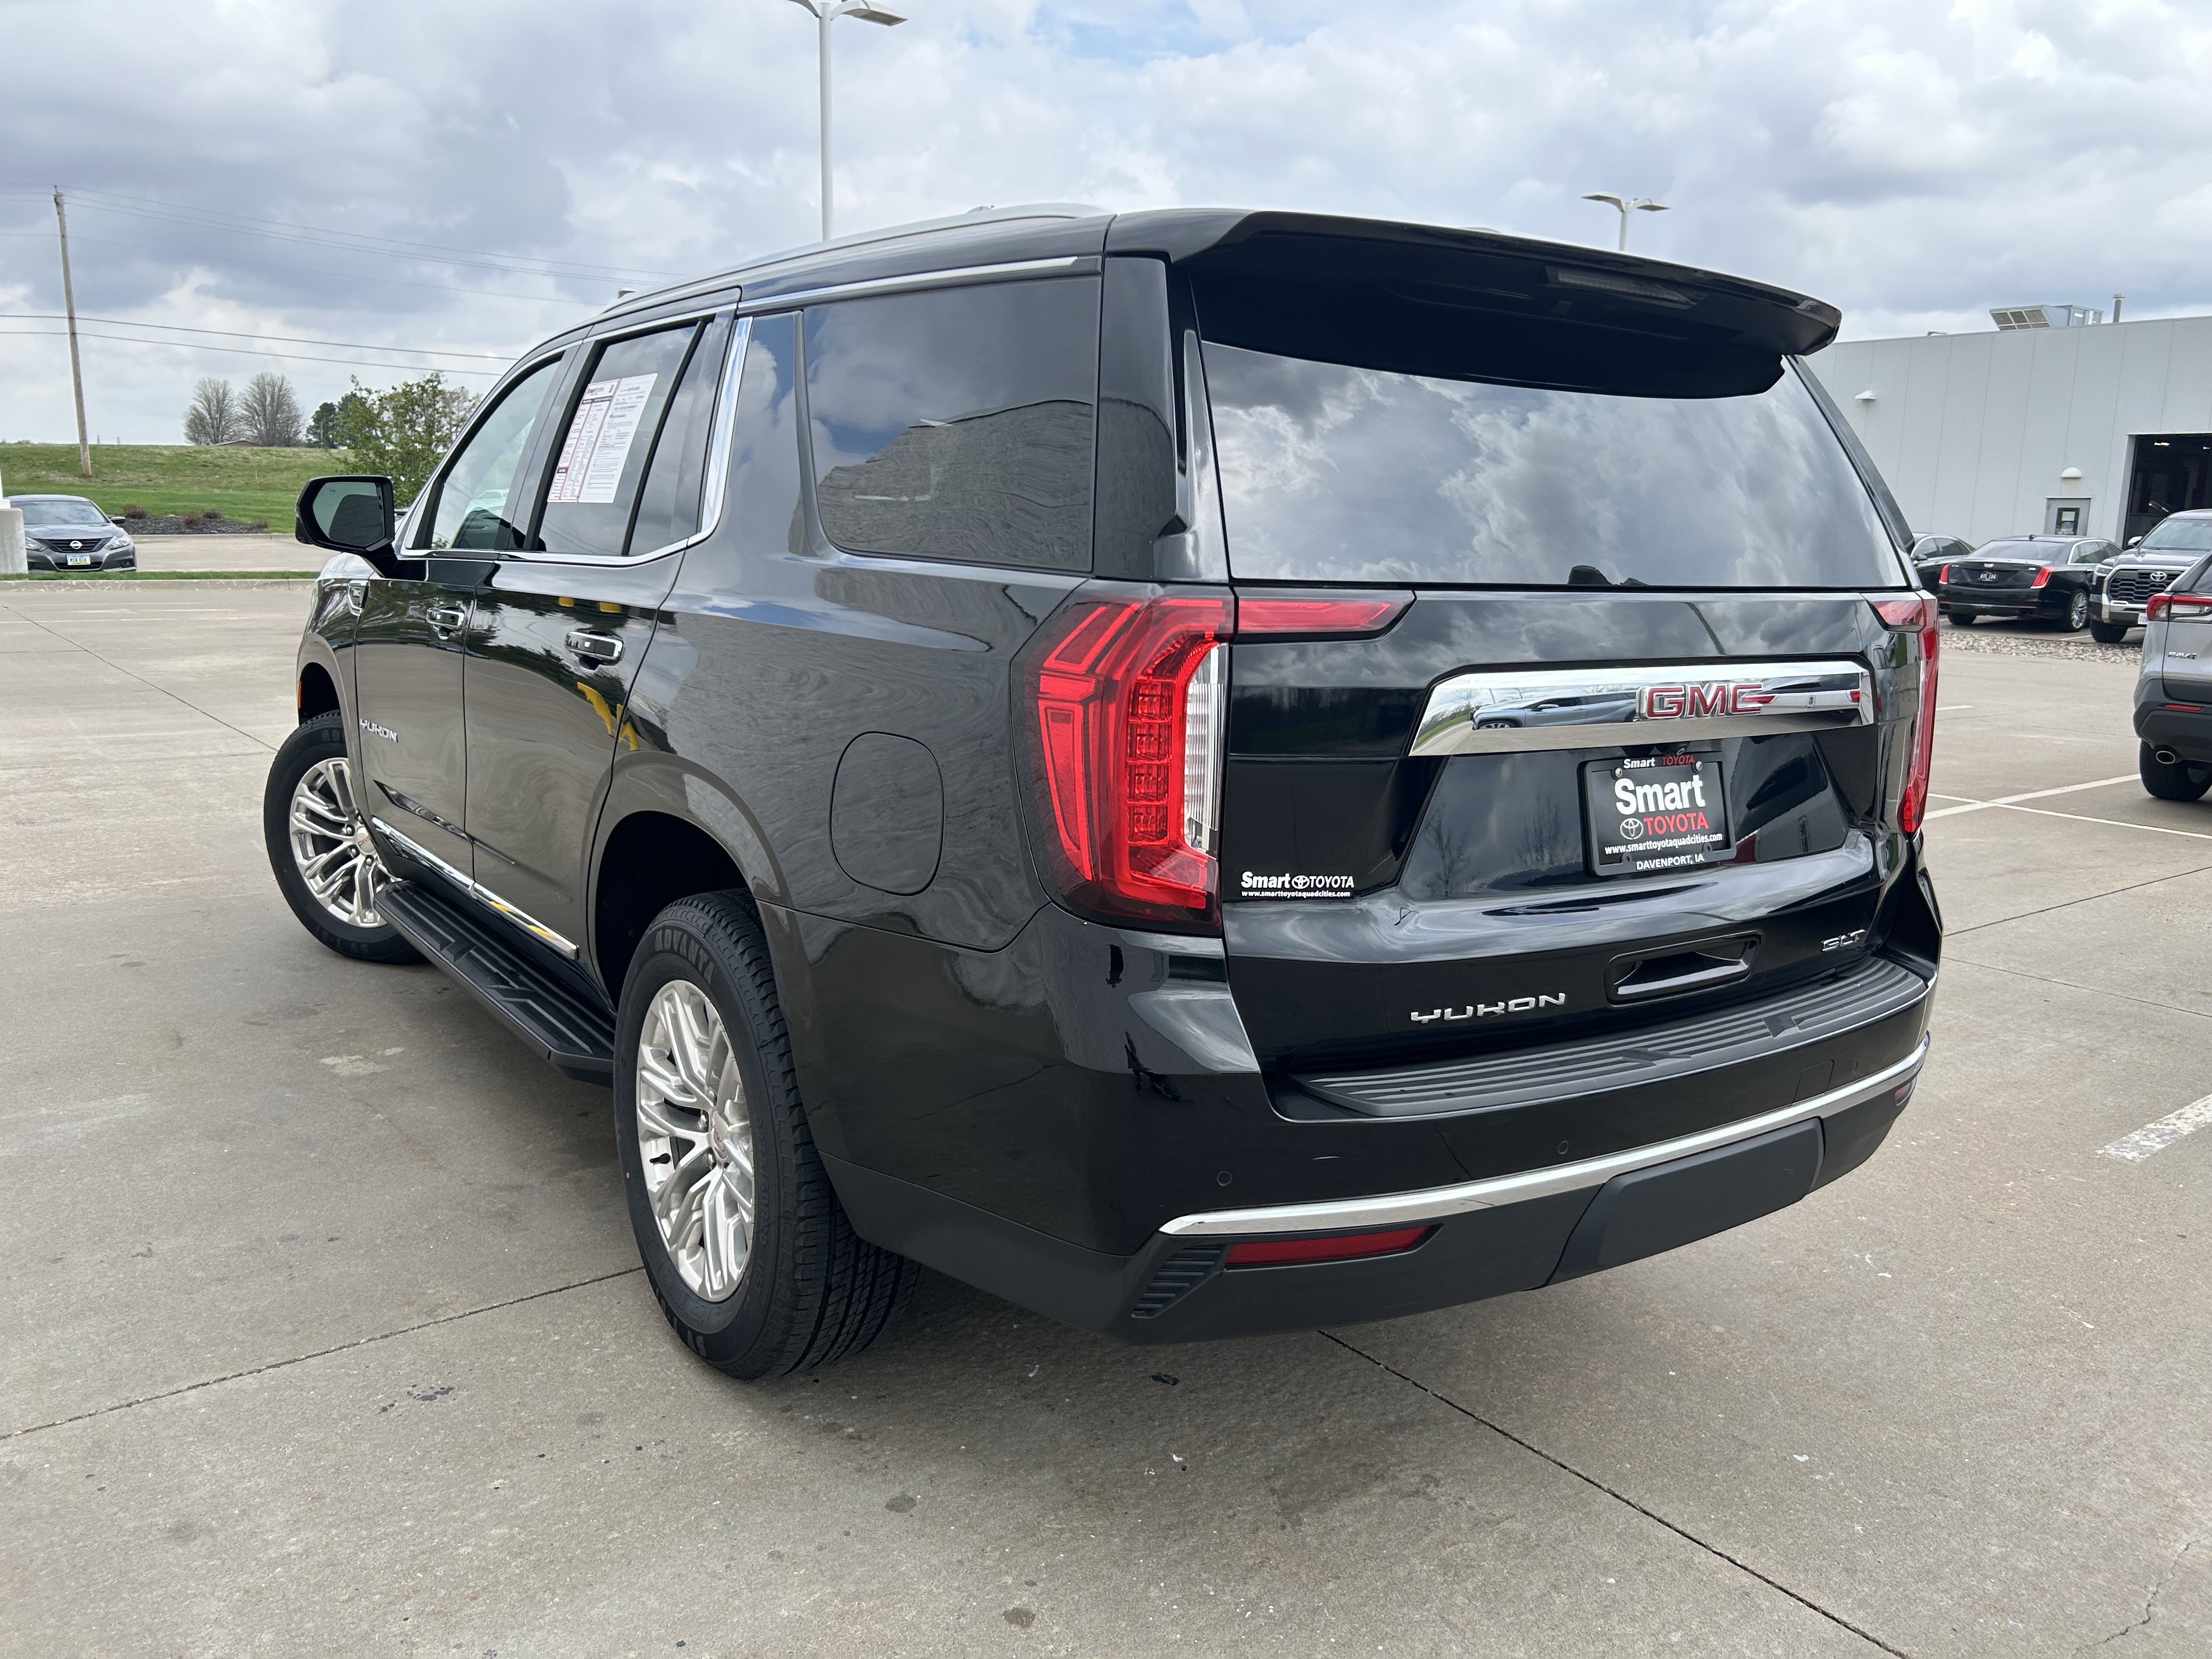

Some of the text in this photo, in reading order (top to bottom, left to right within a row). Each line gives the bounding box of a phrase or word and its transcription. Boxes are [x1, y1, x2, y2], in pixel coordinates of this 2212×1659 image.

[1639, 682, 1764, 720] GMC
[359, 718, 398, 743] YUKON
[1623, 754, 1695, 769] Smart TOYOTA
[1615, 775, 1706, 815] Smart
[1643, 812, 1709, 836] TOYOTA
[1604, 833, 1723, 854] www.smarttoyotaquadcities.com
[1636, 853, 1705, 870] DAVENPORT, IA
[1240, 871, 1355, 889] Smart TOYOTA
[1821, 929, 1866, 952] SLT
[654, 929, 714, 986] ADVANTA
[1410, 992, 1566, 1024] YUKON
